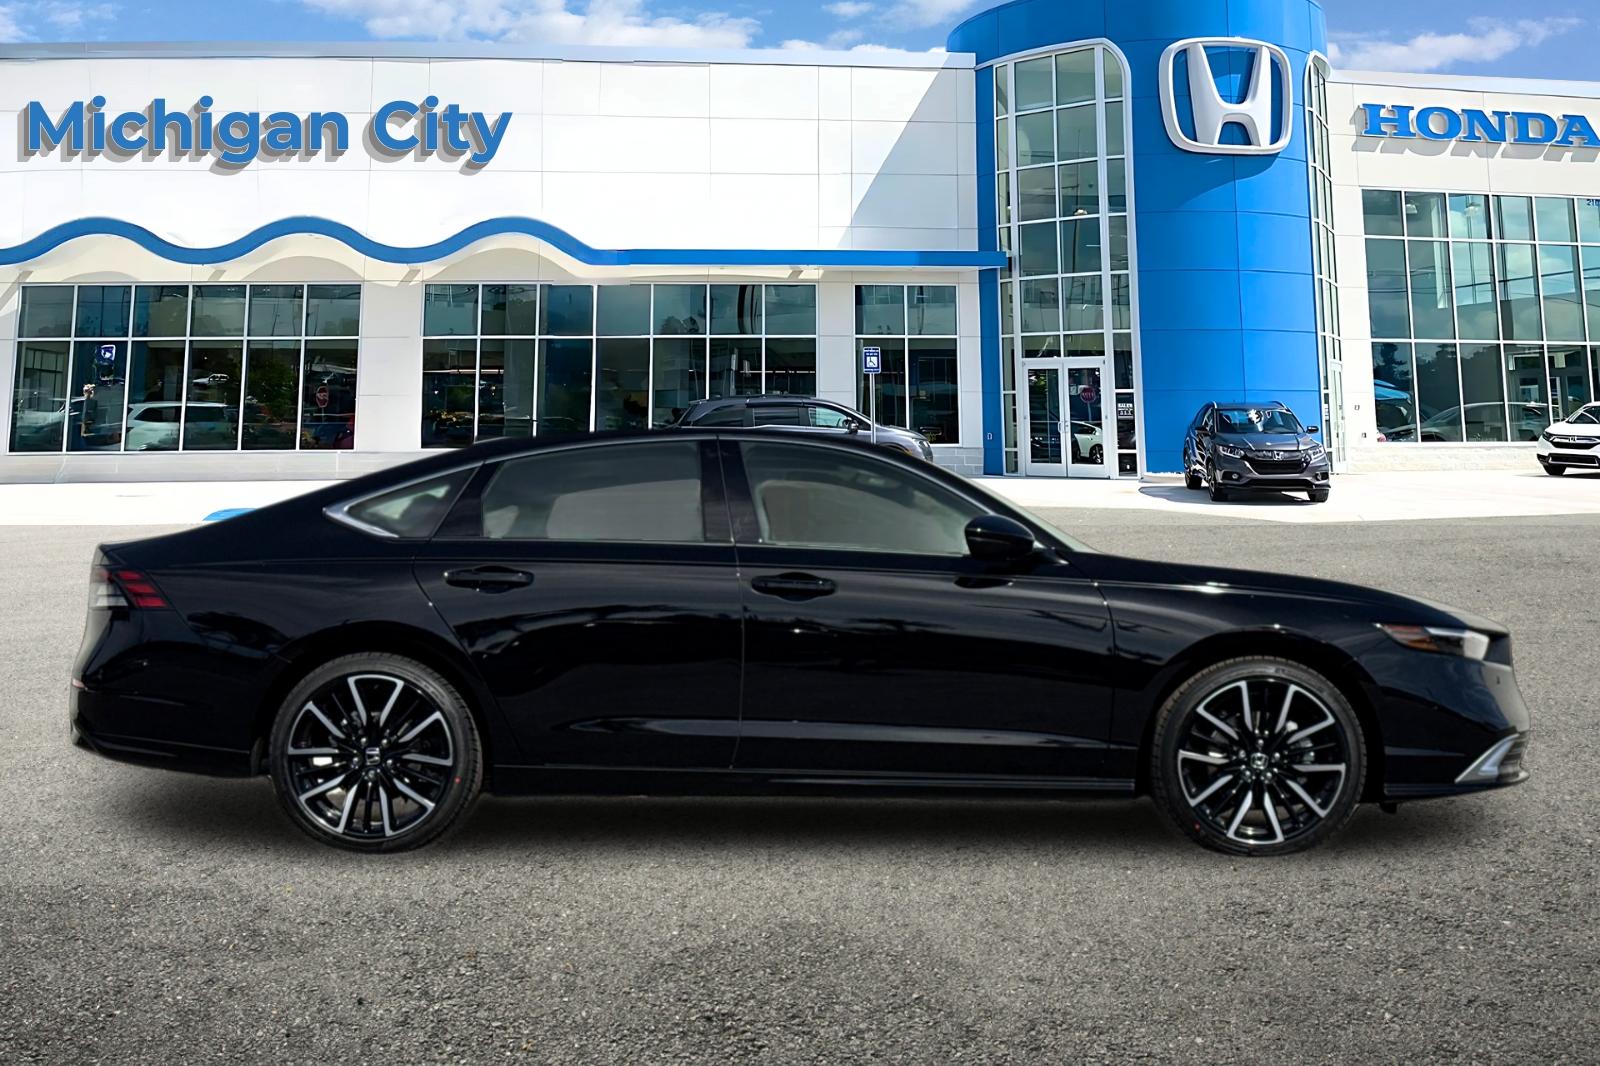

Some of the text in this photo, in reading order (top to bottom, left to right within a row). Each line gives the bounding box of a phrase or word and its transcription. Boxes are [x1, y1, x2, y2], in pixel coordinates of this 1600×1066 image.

[28, 95, 513, 164] Michigan City
[1361, 103, 1600, 148] HONDA
